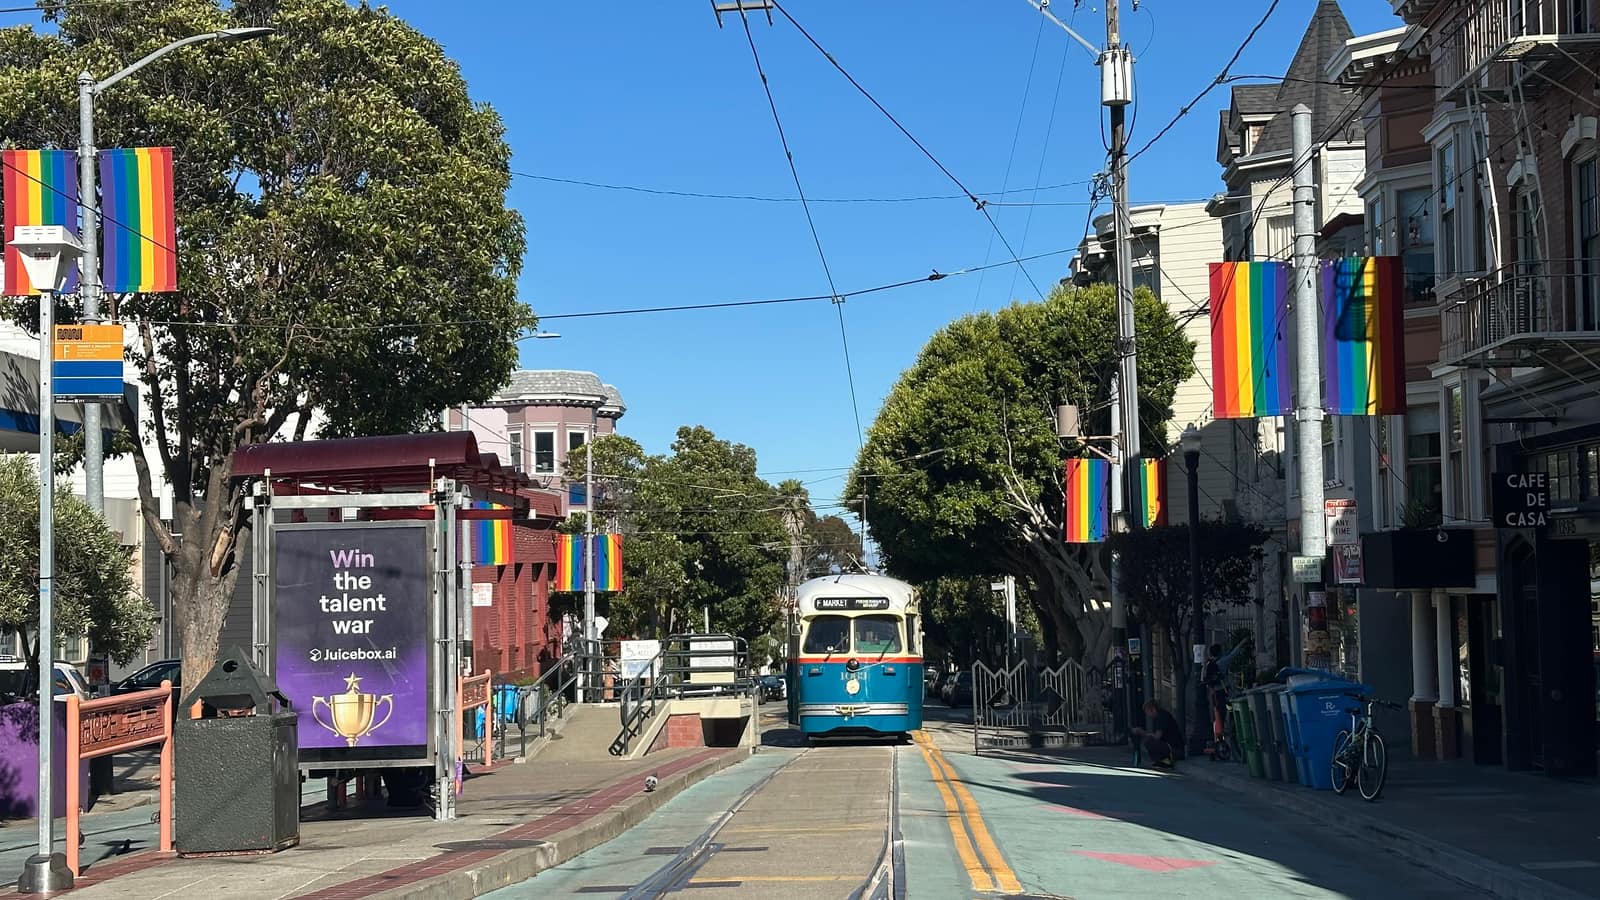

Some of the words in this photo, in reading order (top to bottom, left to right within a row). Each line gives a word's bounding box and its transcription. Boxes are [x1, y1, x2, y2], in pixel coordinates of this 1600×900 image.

[63, 344, 70, 359] F
[1506, 473, 1545, 488] CAFE
[1526, 492, 1546, 507] DE
[1335, 519, 1350, 527] ANY
[1505, 511, 1546, 527] CASA
[1334, 527, 1351, 536] TIME
[329, 548, 375, 569] Win
[333, 571, 372, 590] the
[319, 593, 387, 612] talent
[822, 599, 847, 607] MARKET
[332, 619, 374, 635] war
[323, 646, 397, 661] Juicebox.ai
